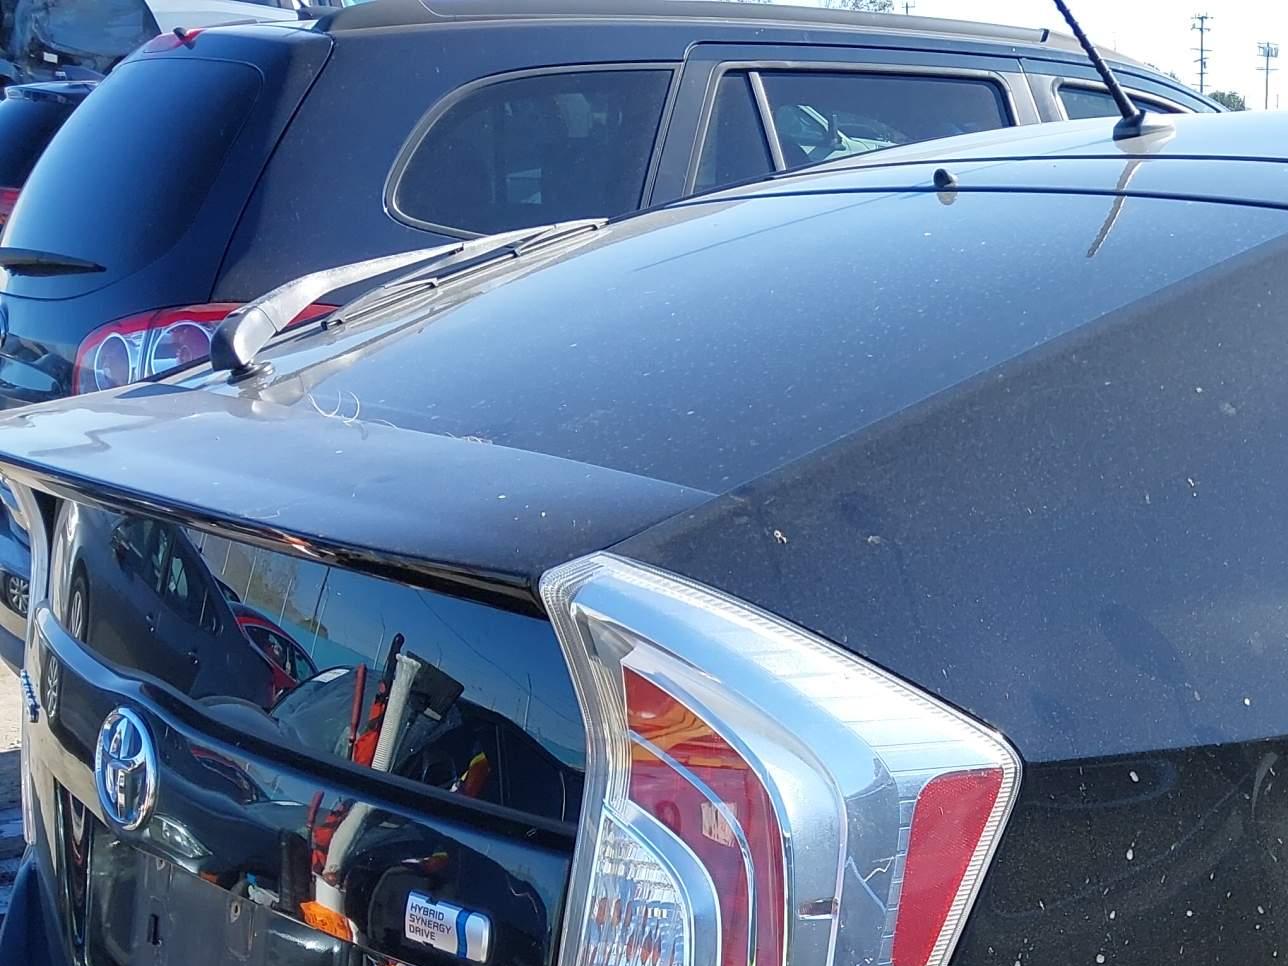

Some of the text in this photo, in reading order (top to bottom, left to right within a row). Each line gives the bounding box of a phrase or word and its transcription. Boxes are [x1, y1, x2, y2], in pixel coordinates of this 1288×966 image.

[410, 902, 445, 921] HYBRID
[409, 914, 452, 934] SYNERGY
[409, 924, 436, 940] DRIVE
